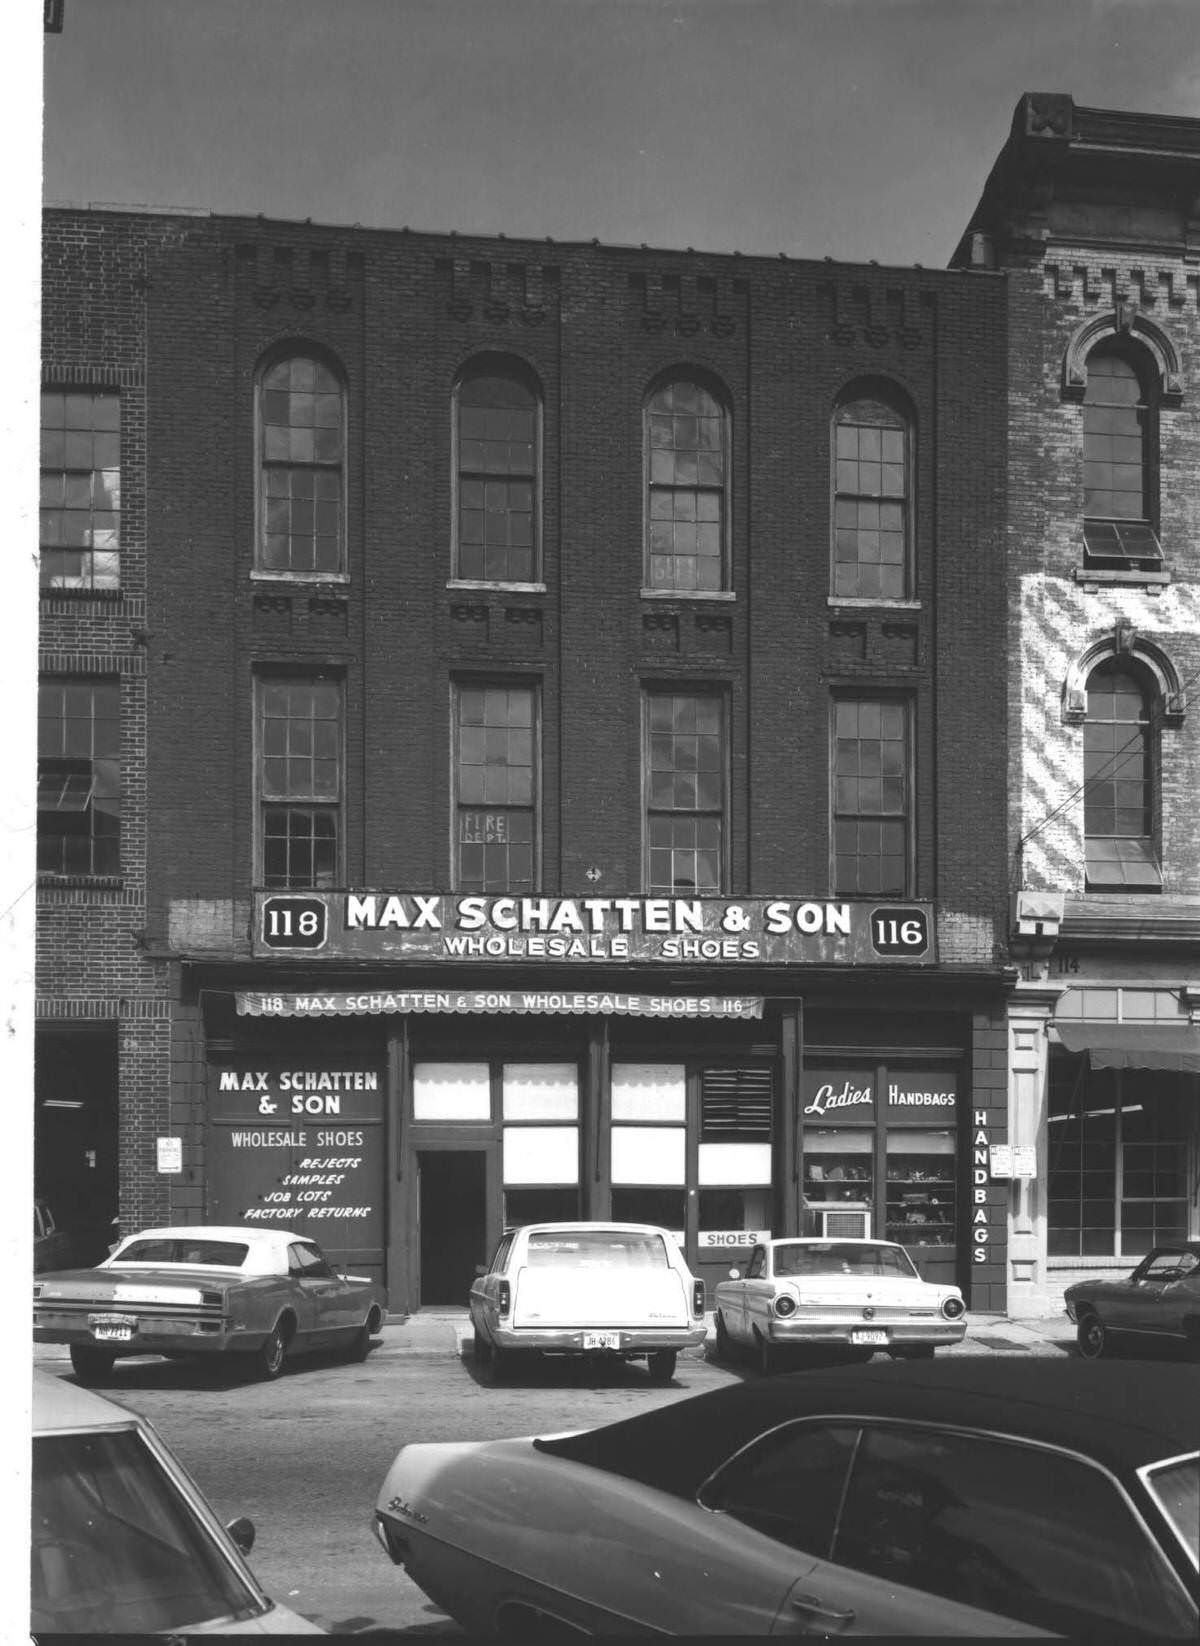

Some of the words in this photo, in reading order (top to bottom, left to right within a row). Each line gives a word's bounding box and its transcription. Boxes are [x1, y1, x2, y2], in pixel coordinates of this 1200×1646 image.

[465, 812, 504, 832] FIRE
[269, 910, 318, 936] 118
[347, 895, 442, 929] MAX
[457, 897, 704, 933] SCHATTEN
[723, 905, 751, 932] &
[766, 902, 852, 934] SON
[877, 919, 923, 945] 116
[444, 934, 628, 958] WHOLESALE
[661, 939, 760, 959] SHOES
[1060, 956, 1080, 973] 114
[260, 998, 284, 1012] 118
[295, 998, 337, 1011] MAX
[345, 994, 450, 1010] SCHATTEN
[457, 996, 467, 1009] &
[474, 994, 511, 1009] SON
[522, 994, 641, 1011] WHOLESALE
[649, 998, 711, 1013] SHOES
[722, 1000, 743, 1013] 116
[218, 1071, 269, 1091] MAX
[279, 1071, 378, 1091] SCHATTEN
[257, 1095, 279, 1114] &
[291, 1095, 341, 1114] SON
[804, 1081, 873, 1115] Ladies
[888, 1084, 956, 1106] HANDBAGS
[231, 1131, 307, 1147] WHOLESALE
[317, 1131, 363, 1147] SHOES
[299, 1157, 362, 1169] REJECTS
[281, 1174, 345, 1186] SAMPLES
[974, 1111, 989, 1264] HANDBAGS
[264, 1192, 292, 1203] JOB
[297, 1190, 332, 1202] LOTS
[243, 1207, 303, 1220] FACTORY
[307, 1206, 372, 1218] RETURNS
[707, 1233, 758, 1245] SHOES
